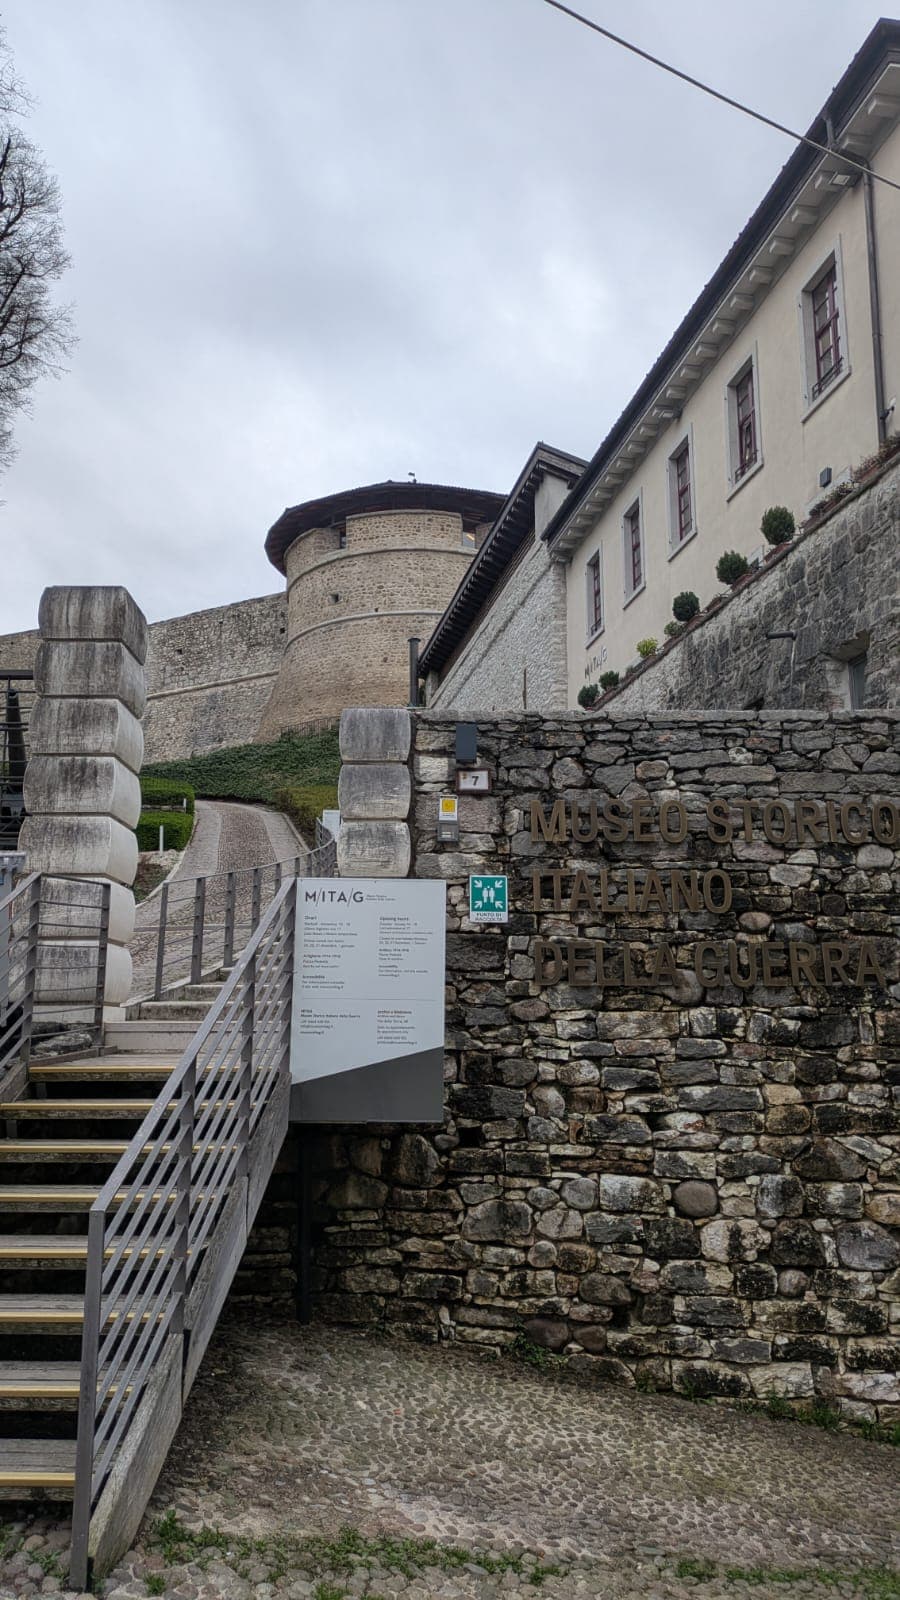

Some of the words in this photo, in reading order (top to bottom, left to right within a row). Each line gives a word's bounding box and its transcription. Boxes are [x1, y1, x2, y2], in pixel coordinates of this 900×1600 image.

[471, 775, 480, 786] 7
[530, 800, 689, 843] MUSEO
[706, 800, 900, 844] STORICO
[532, 868, 733, 913] ITALIANO
[534, 941, 680, 987] DELLA
[698, 941, 886, 988] GUERRA
